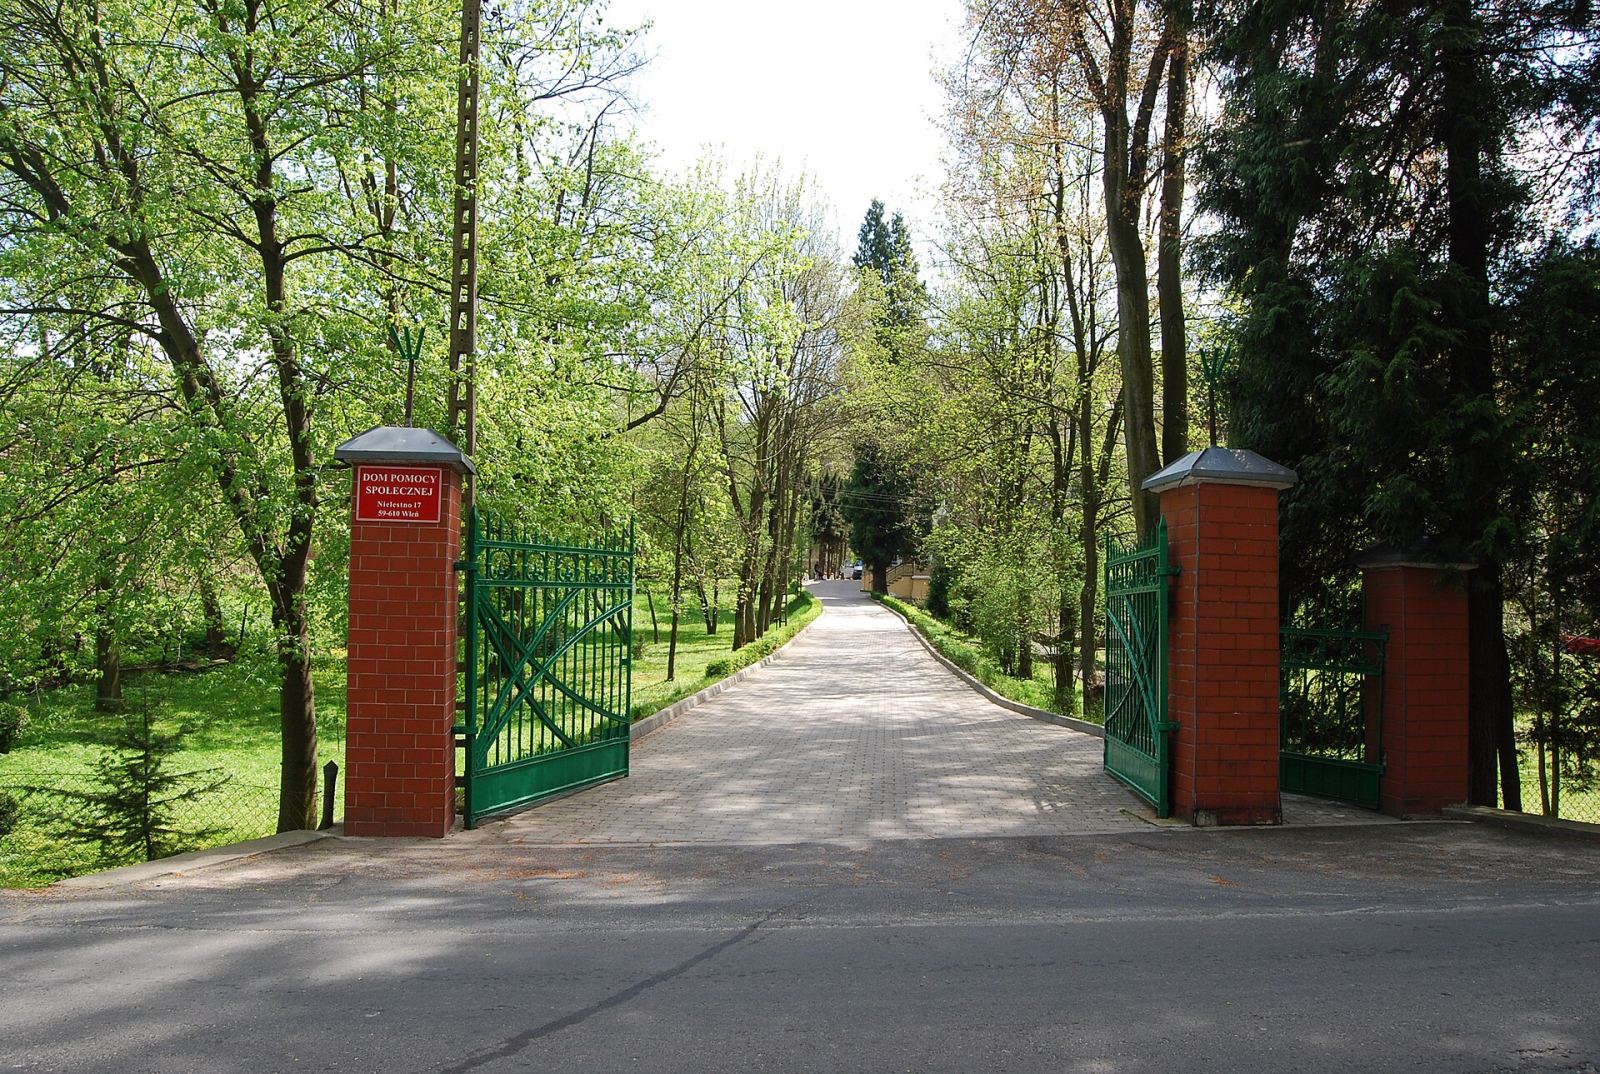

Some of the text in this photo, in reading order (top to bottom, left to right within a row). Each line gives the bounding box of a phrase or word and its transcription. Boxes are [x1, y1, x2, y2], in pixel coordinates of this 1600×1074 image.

[363, 473, 438, 484] DOM POMOCY
[378, 509, 400, 517] 59-610
